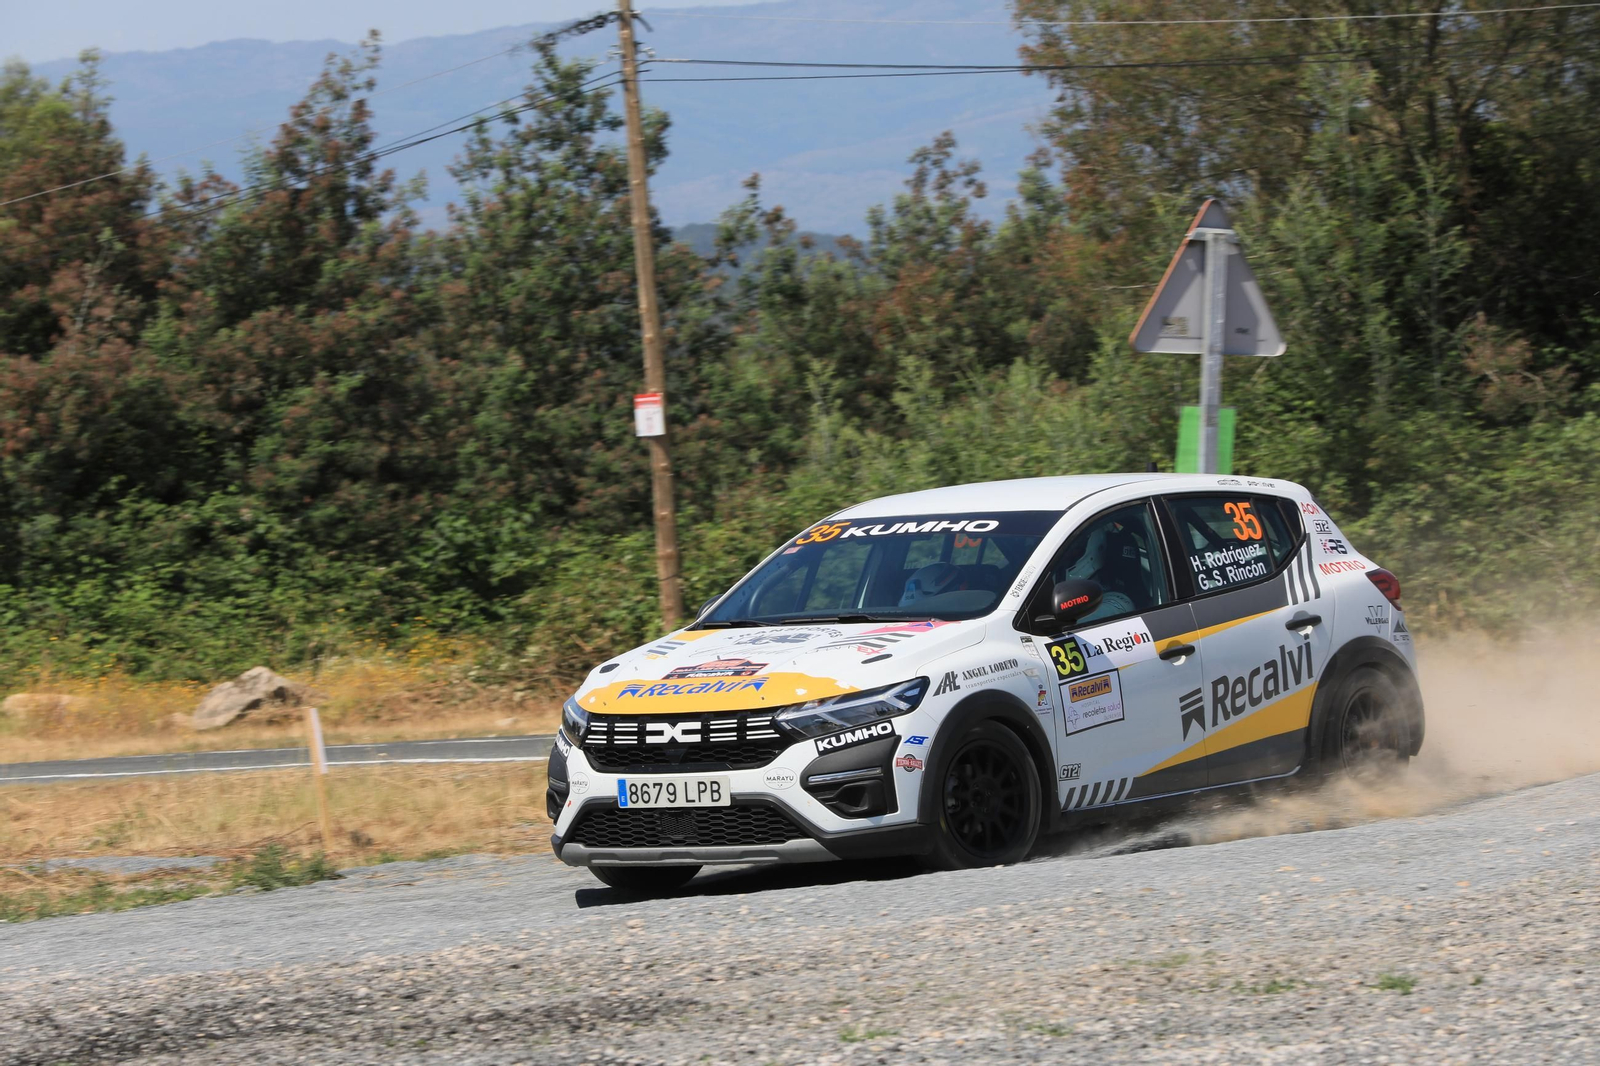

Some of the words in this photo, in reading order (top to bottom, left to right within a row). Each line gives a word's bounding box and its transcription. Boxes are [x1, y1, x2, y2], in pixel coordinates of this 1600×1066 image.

[796, 522, 850, 544] 35
[840, 520, 999, 538] KUMHO
[1223, 502, 1262, 540] 35
[1190, 555, 1206, 572] H.
[1204, 543, 1262, 569] Rodríguez
[1319, 560, 1366, 575] MOTRIO
[1198, 574, 1213, 590] G.
[1212, 570, 1227, 586] S.
[1226, 560, 1267, 583] Rincón
[1060, 595, 1089, 610] MOTRIO
[1083, 642, 1104, 658] La
[1103, 631, 1151, 653] Región
[962, 666, 989, 681] ANGEL
[988, 658, 1019, 674] LOBETO
[1051, 641, 1085, 676] 35
[638, 680, 746, 698] Recalvi
[966, 678, 996, 689] transportes
[1077, 680, 1103, 697] Recalvi
[1211, 633, 1313, 728] Recalvi
[1083, 705, 1106, 718] recoletas
[1107, 701, 1121, 712] salud
[817, 722, 893, 752] KUMHO
[629, 782, 678, 805] 8679
[684, 780, 722, 804] LPB
